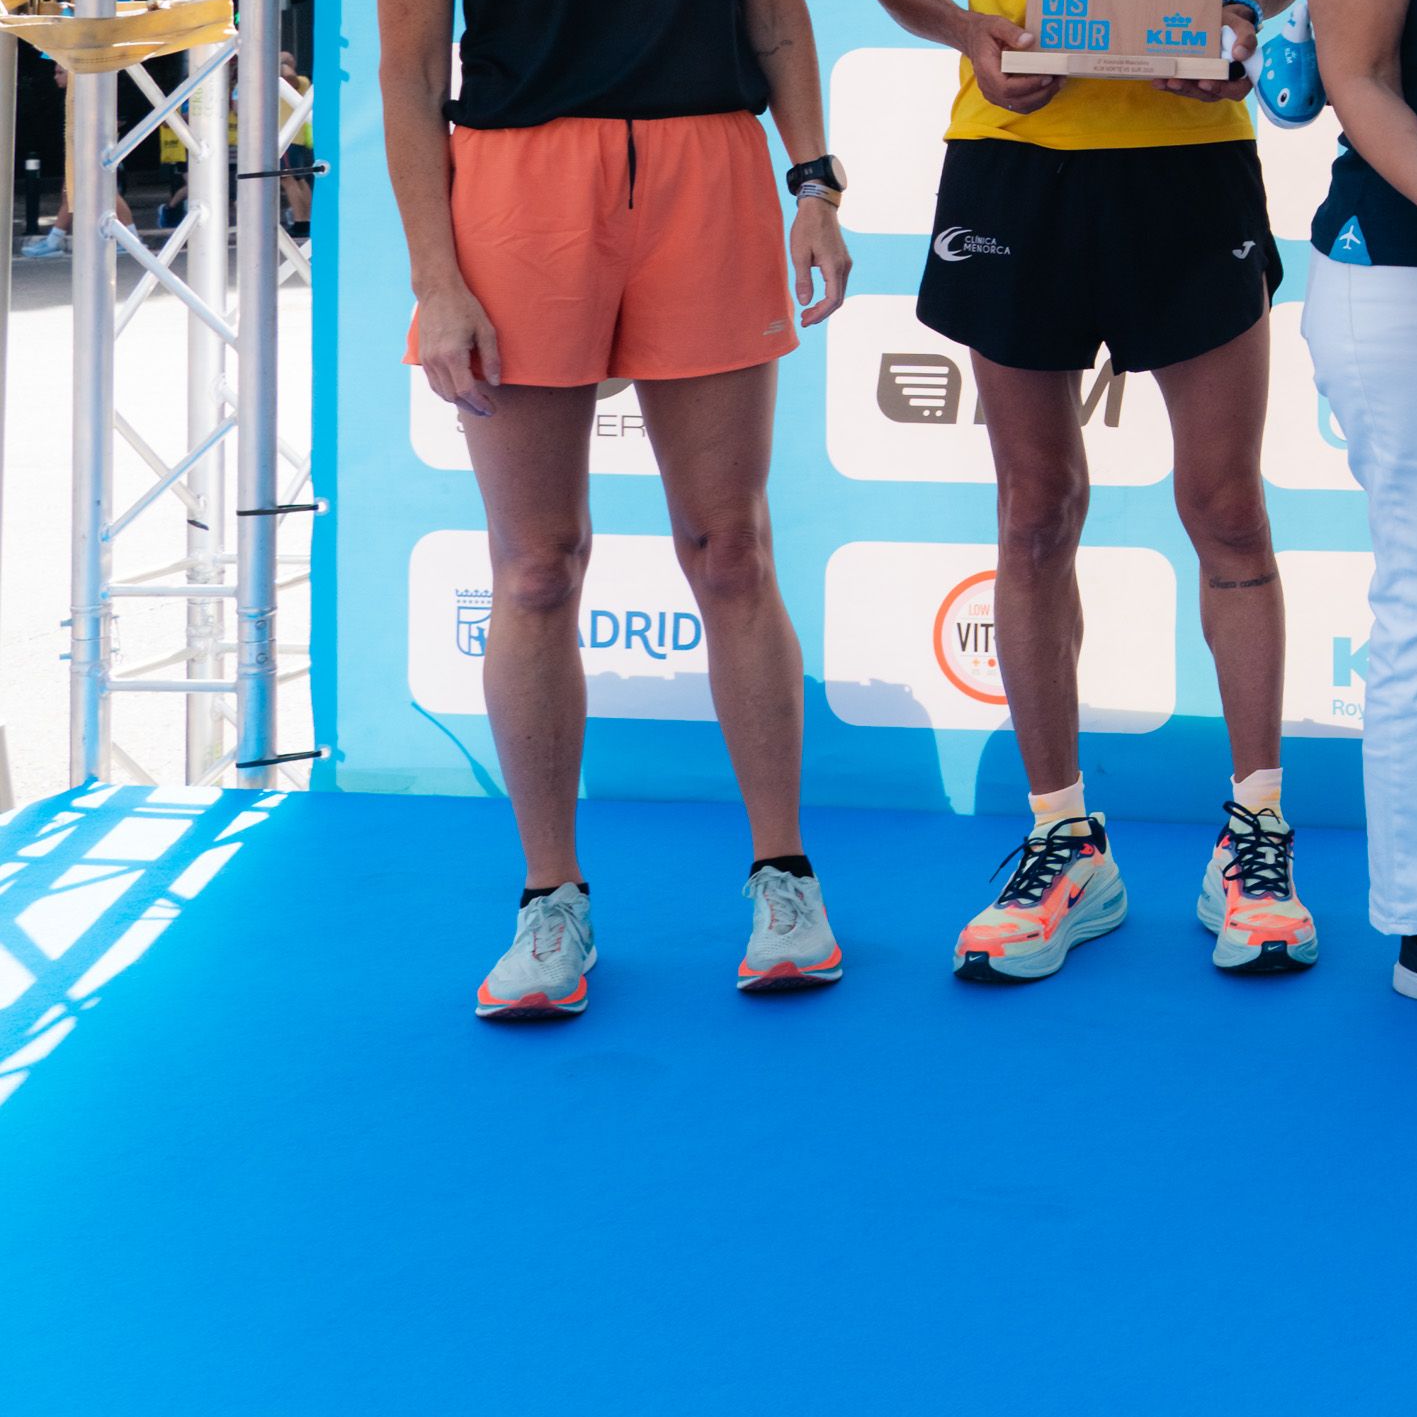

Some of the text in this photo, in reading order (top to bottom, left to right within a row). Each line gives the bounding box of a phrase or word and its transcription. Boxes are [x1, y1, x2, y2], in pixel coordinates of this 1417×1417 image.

[1043, 20, 1109, 49] SUR
[1147, 29, 1206, 47] KLM
[963, 243, 1011, 255] MENORCA
[578, 610, 702, 660] DRID
